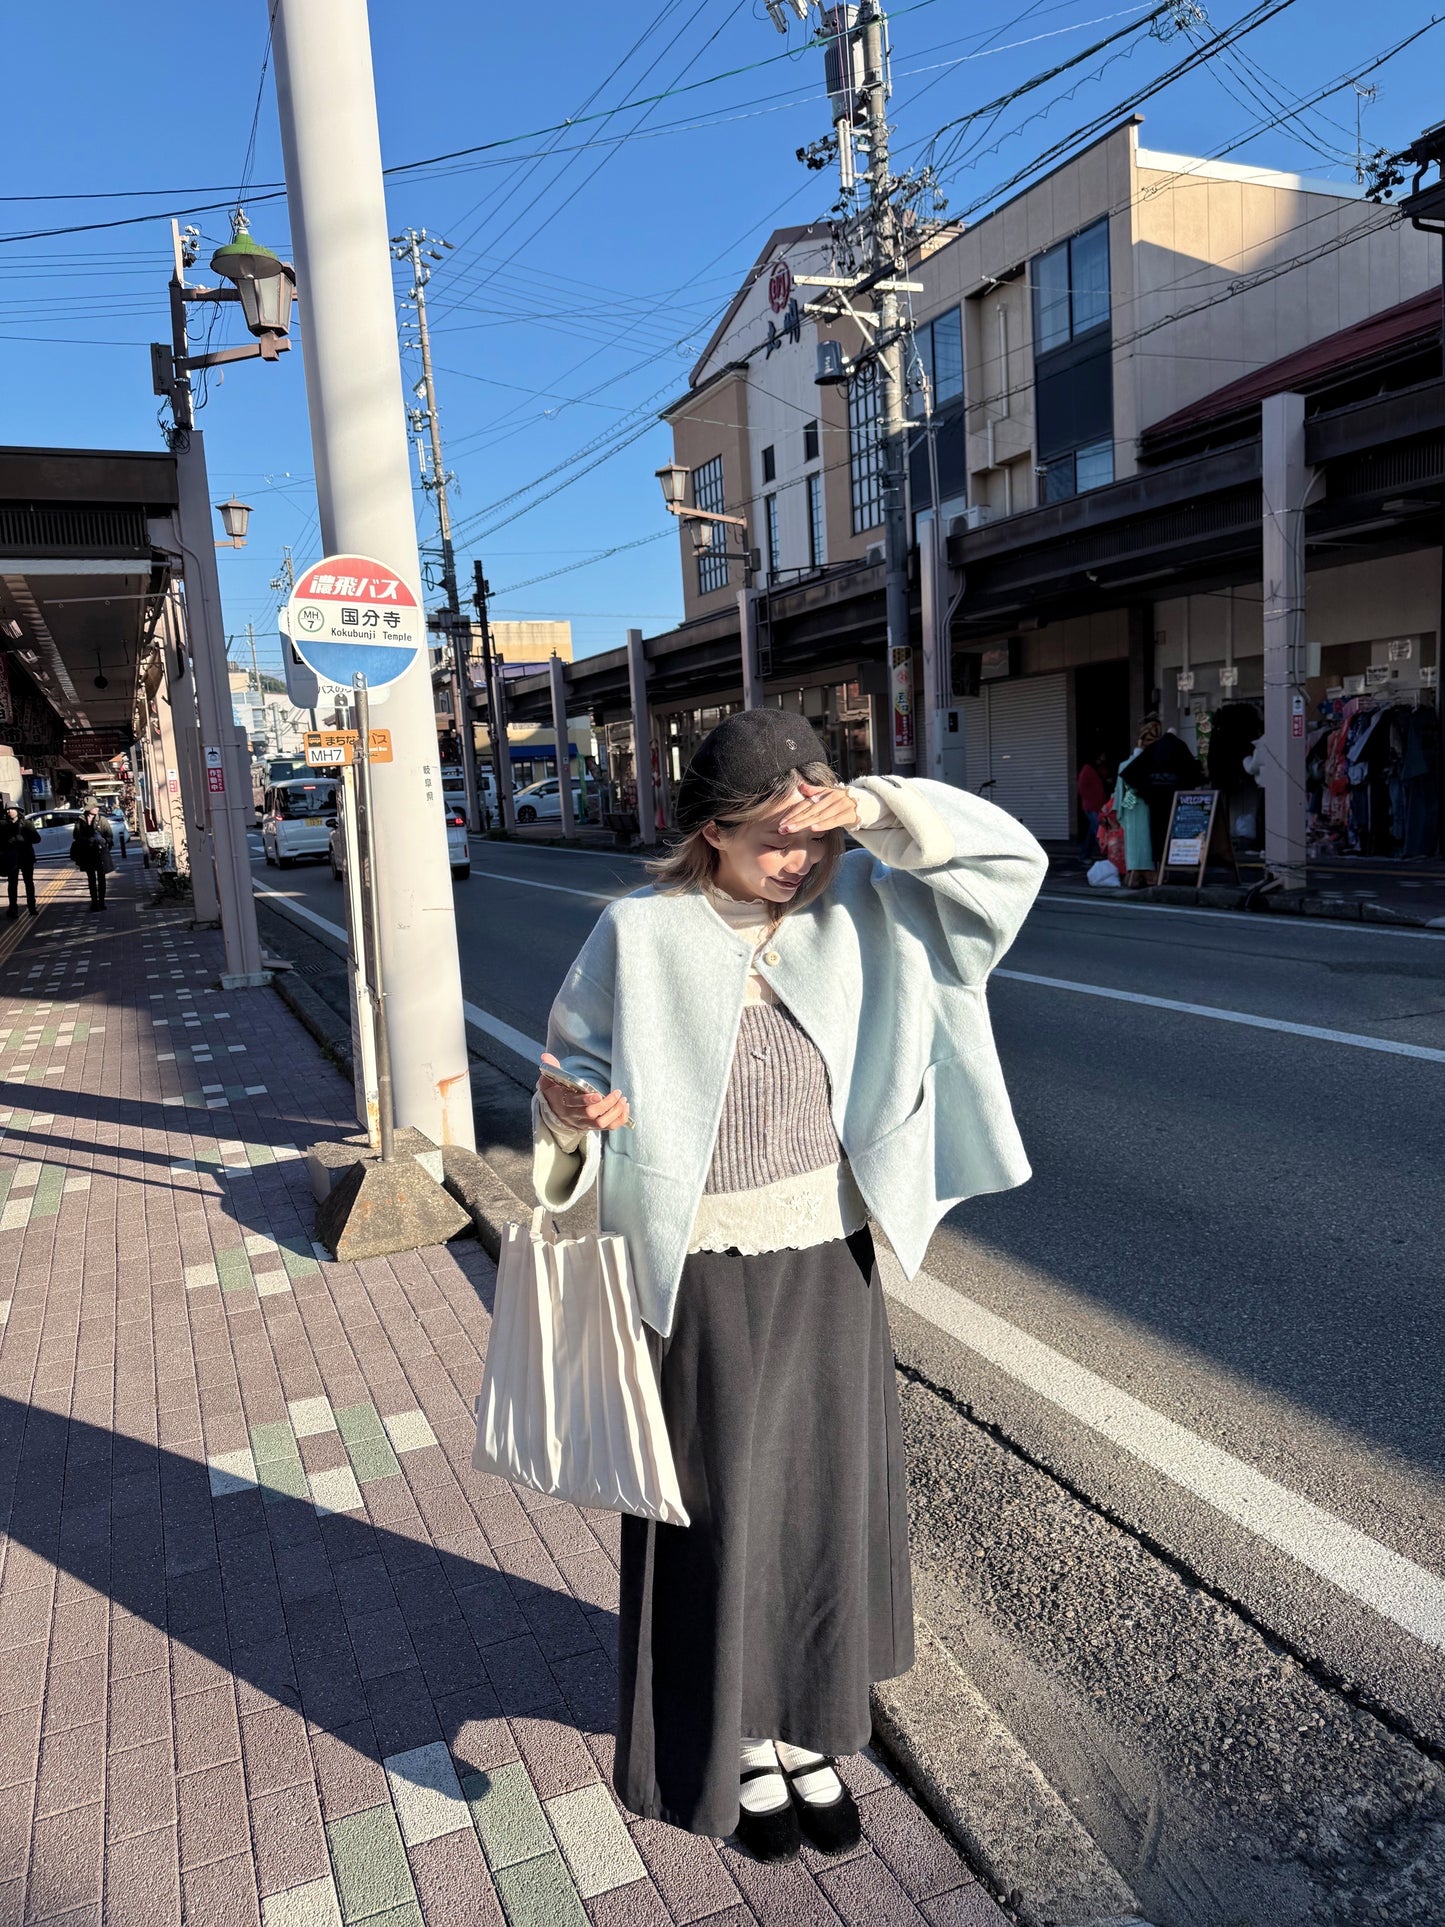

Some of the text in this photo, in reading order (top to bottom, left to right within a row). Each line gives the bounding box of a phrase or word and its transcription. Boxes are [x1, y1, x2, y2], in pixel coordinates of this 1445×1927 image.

[309, 574, 400, 600] 濃飛バス
[303, 610, 319, 619] MH
[341, 607, 401, 629] 国分寺
[307, 620, 315, 629] 7
[331, 627, 413, 642] Kokubunji Temple
[325, 733, 387, 746] まちなバス
[311, 749, 342, 762] MH7
[422, 765, 434, 801] 岐阜県
[1180, 795, 1212, 805] WELCOME
